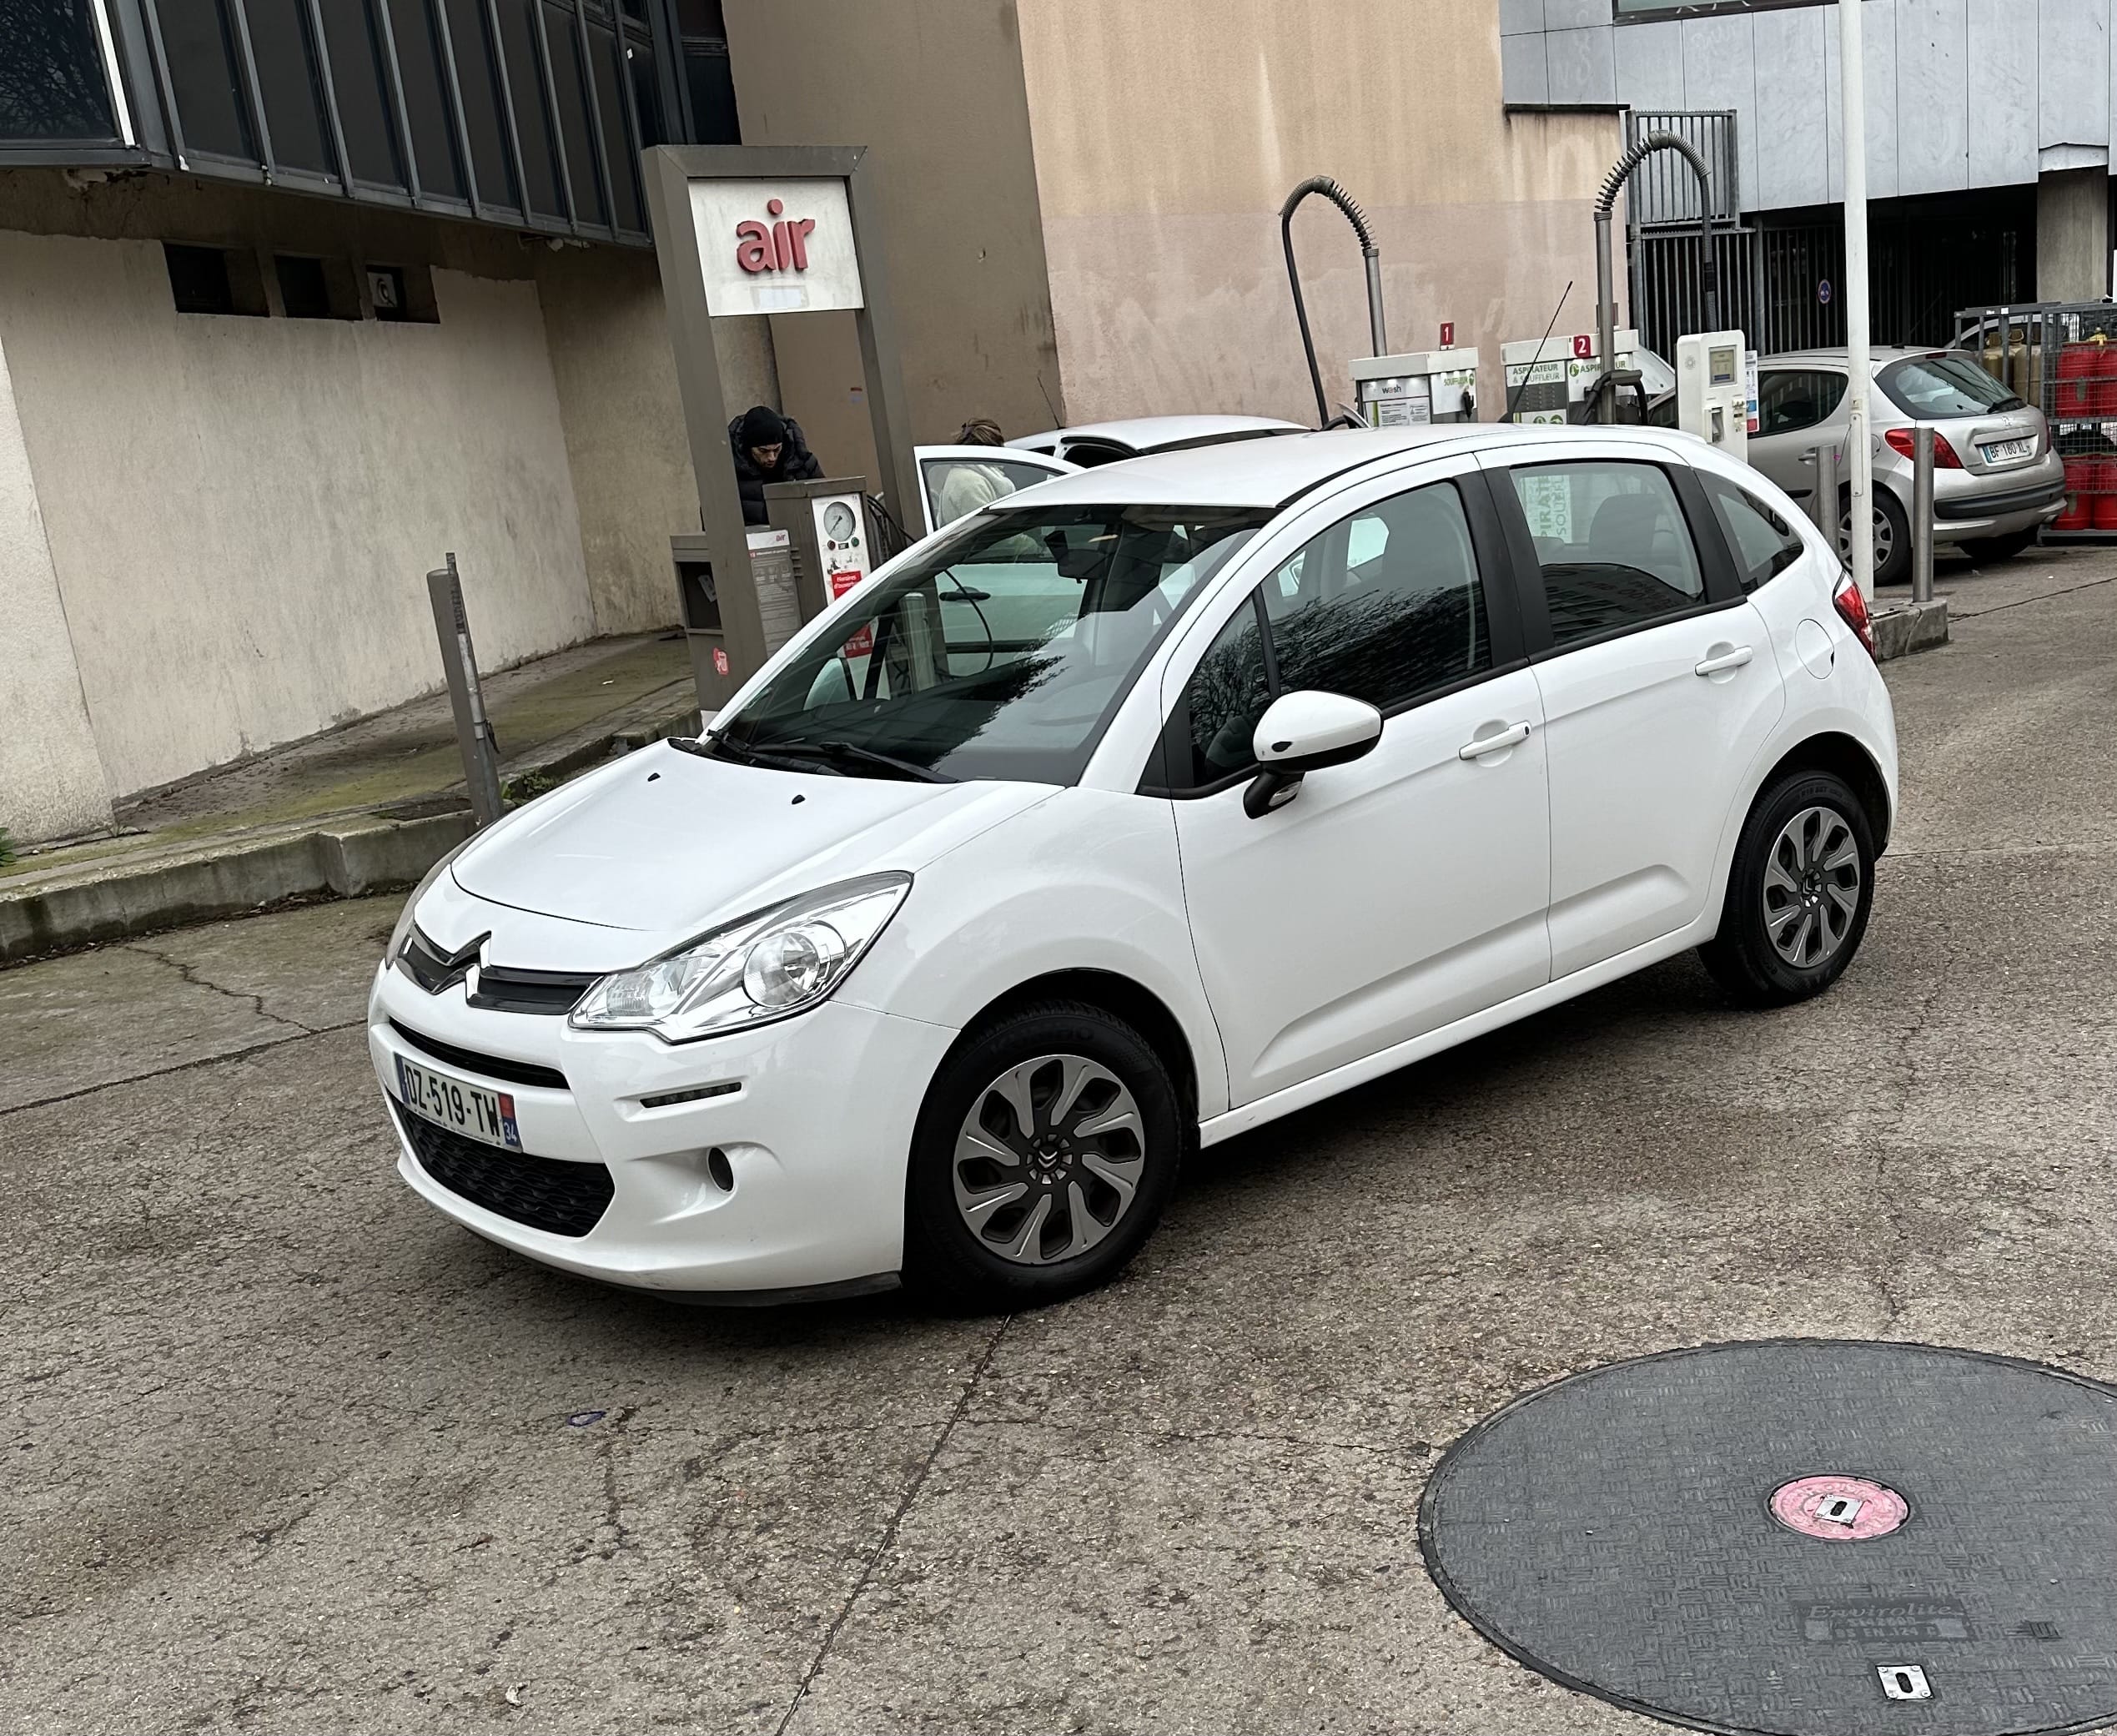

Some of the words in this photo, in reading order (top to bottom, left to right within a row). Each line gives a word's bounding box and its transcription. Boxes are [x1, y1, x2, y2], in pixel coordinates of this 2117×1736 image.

[736, 199, 816, 274] air
[1444, 326, 1450, 342] 1
[1578, 338, 1586, 354] 2
[1382, 385, 1401, 394] wash
[405, 1064, 500, 1137] DZ-519-TW
[504, 1121, 517, 1142] 34
[1808, 1602, 1964, 1619] Envirolite
